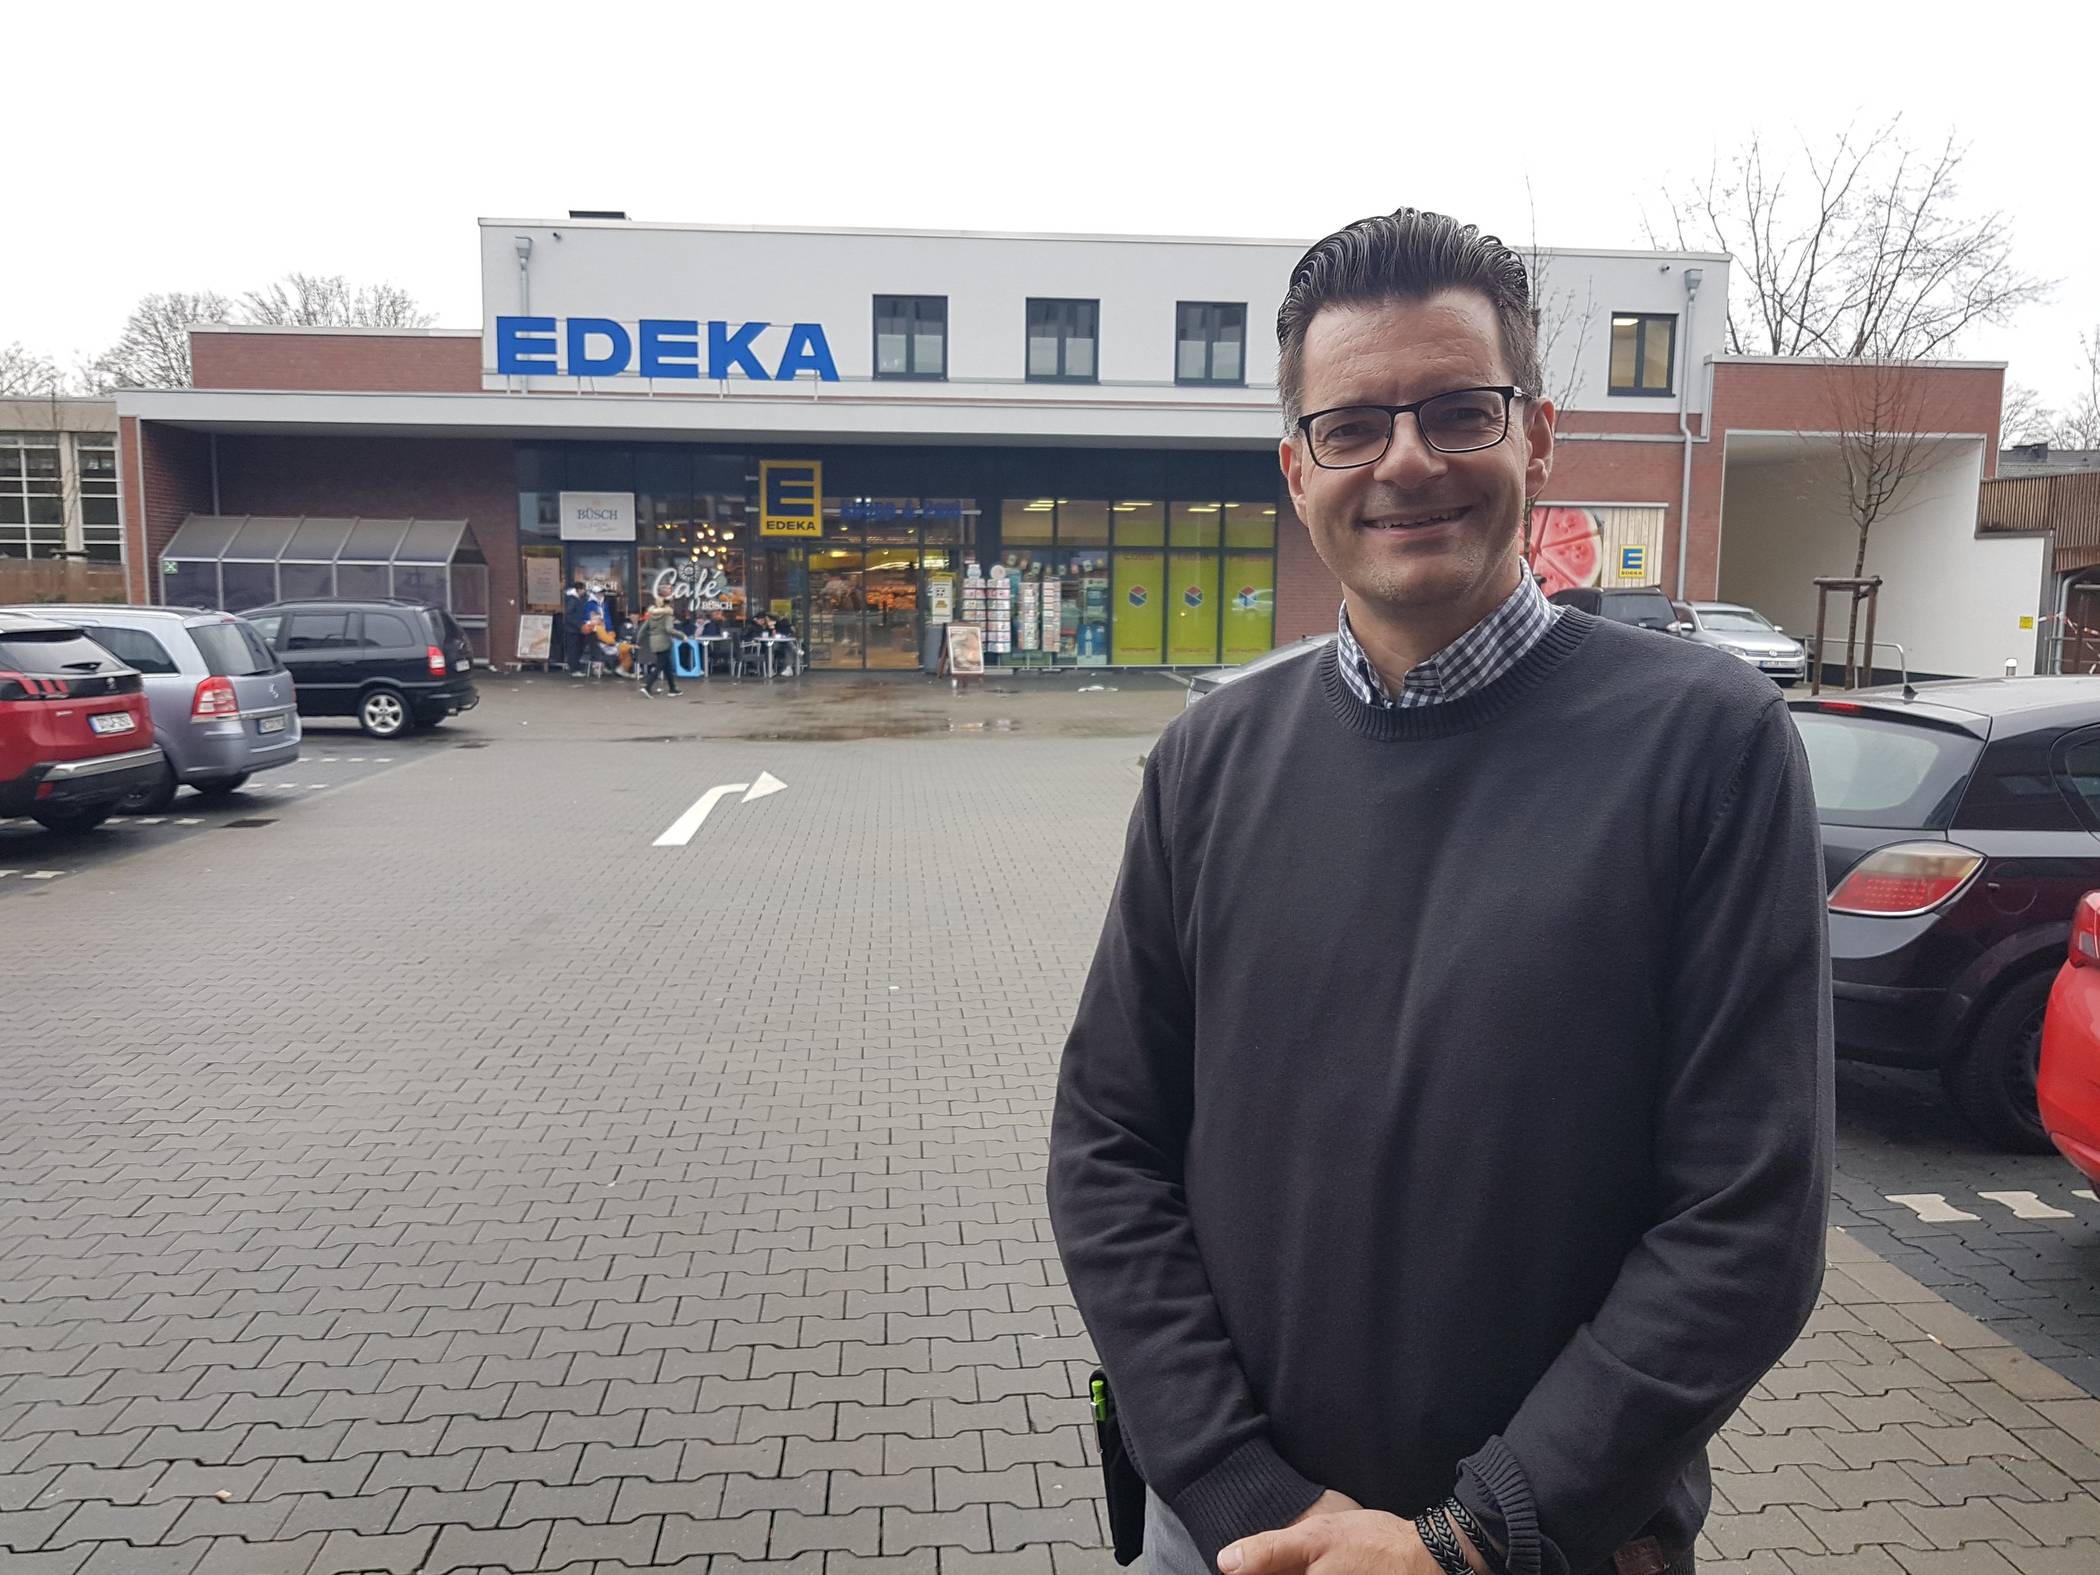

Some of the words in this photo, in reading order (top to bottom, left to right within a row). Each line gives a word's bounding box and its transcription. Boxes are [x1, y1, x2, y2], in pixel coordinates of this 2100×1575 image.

[496, 315, 840, 382] EDEKA
[577, 508, 618, 520] BÜSCH
[767, 468, 814, 516] E
[766, 520, 816, 530] EDEKA
[652, 567, 722, 612] Café
